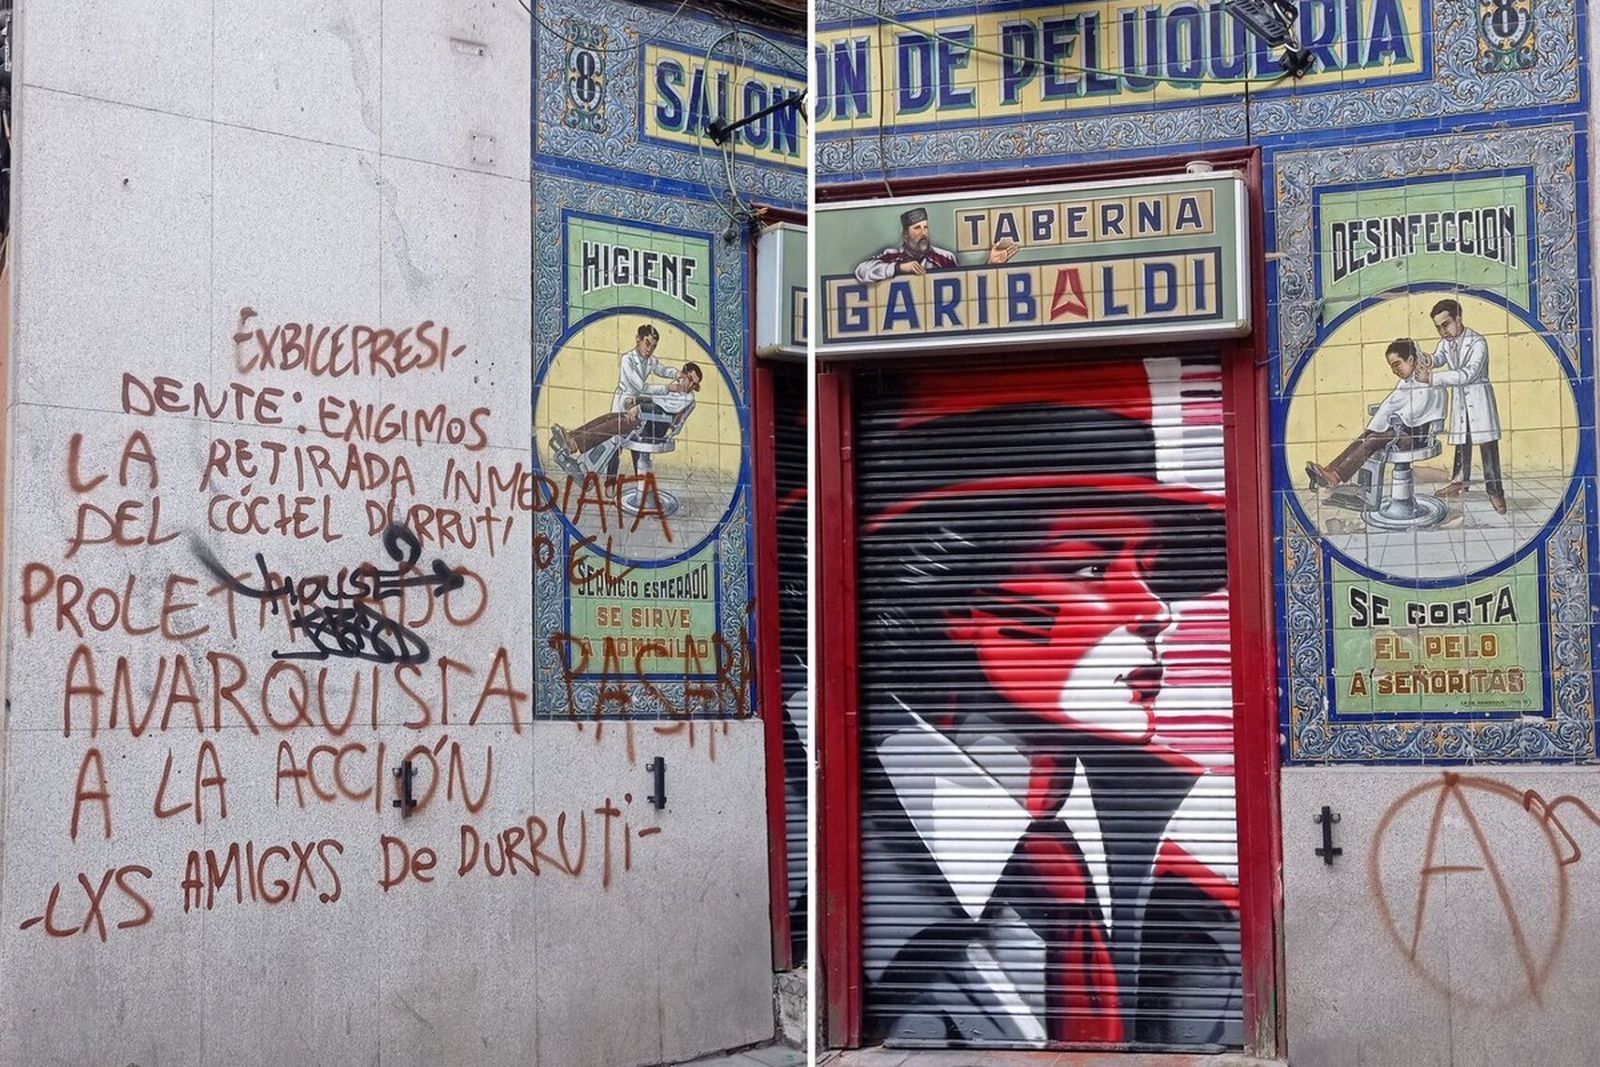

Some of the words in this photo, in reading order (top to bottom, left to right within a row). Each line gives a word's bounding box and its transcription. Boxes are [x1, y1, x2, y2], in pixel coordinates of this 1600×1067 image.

[894, 25, 977, 116] DE
[655, 56, 800, 158] SALON
[962, 197, 1204, 247] TABERNA
[1330, 203, 1519, 285] DESINFECCION
[580, 240, 698, 309] HIGIENE
[836, 258, 1207, 334] GARIBALDI
[66, 431, 158, 494] LA
[199, 438, 416, 503] RETIRADA
[443, 458, 672, 543] INMEDIATA
[64, 497, 181, 559] DEL
[578, 562, 639, 598] SERVICIO
[643, 563, 709, 600] ESMERADO
[1348, 585, 1392, 628] SE
[1405, 583, 1520, 627] CORTA
[580, 636, 594, 658] A
[597, 605, 622, 628] SE
[631, 606, 691, 630] SIRVE
[1374, 633, 1411, 660] EL
[1424, 632, 1499, 661] PELO
[64, 644, 528, 738] ANARQUISTA
[1349, 671, 1368, 697] A
[1377, 664, 1526, 697] SEÑORITAS
[71, 749, 113, 842] A
[154, 741, 228, 824] LA
[277, 734, 492, 813] ACCIÓN
[181, 840, 343, 914] AMIGXS
